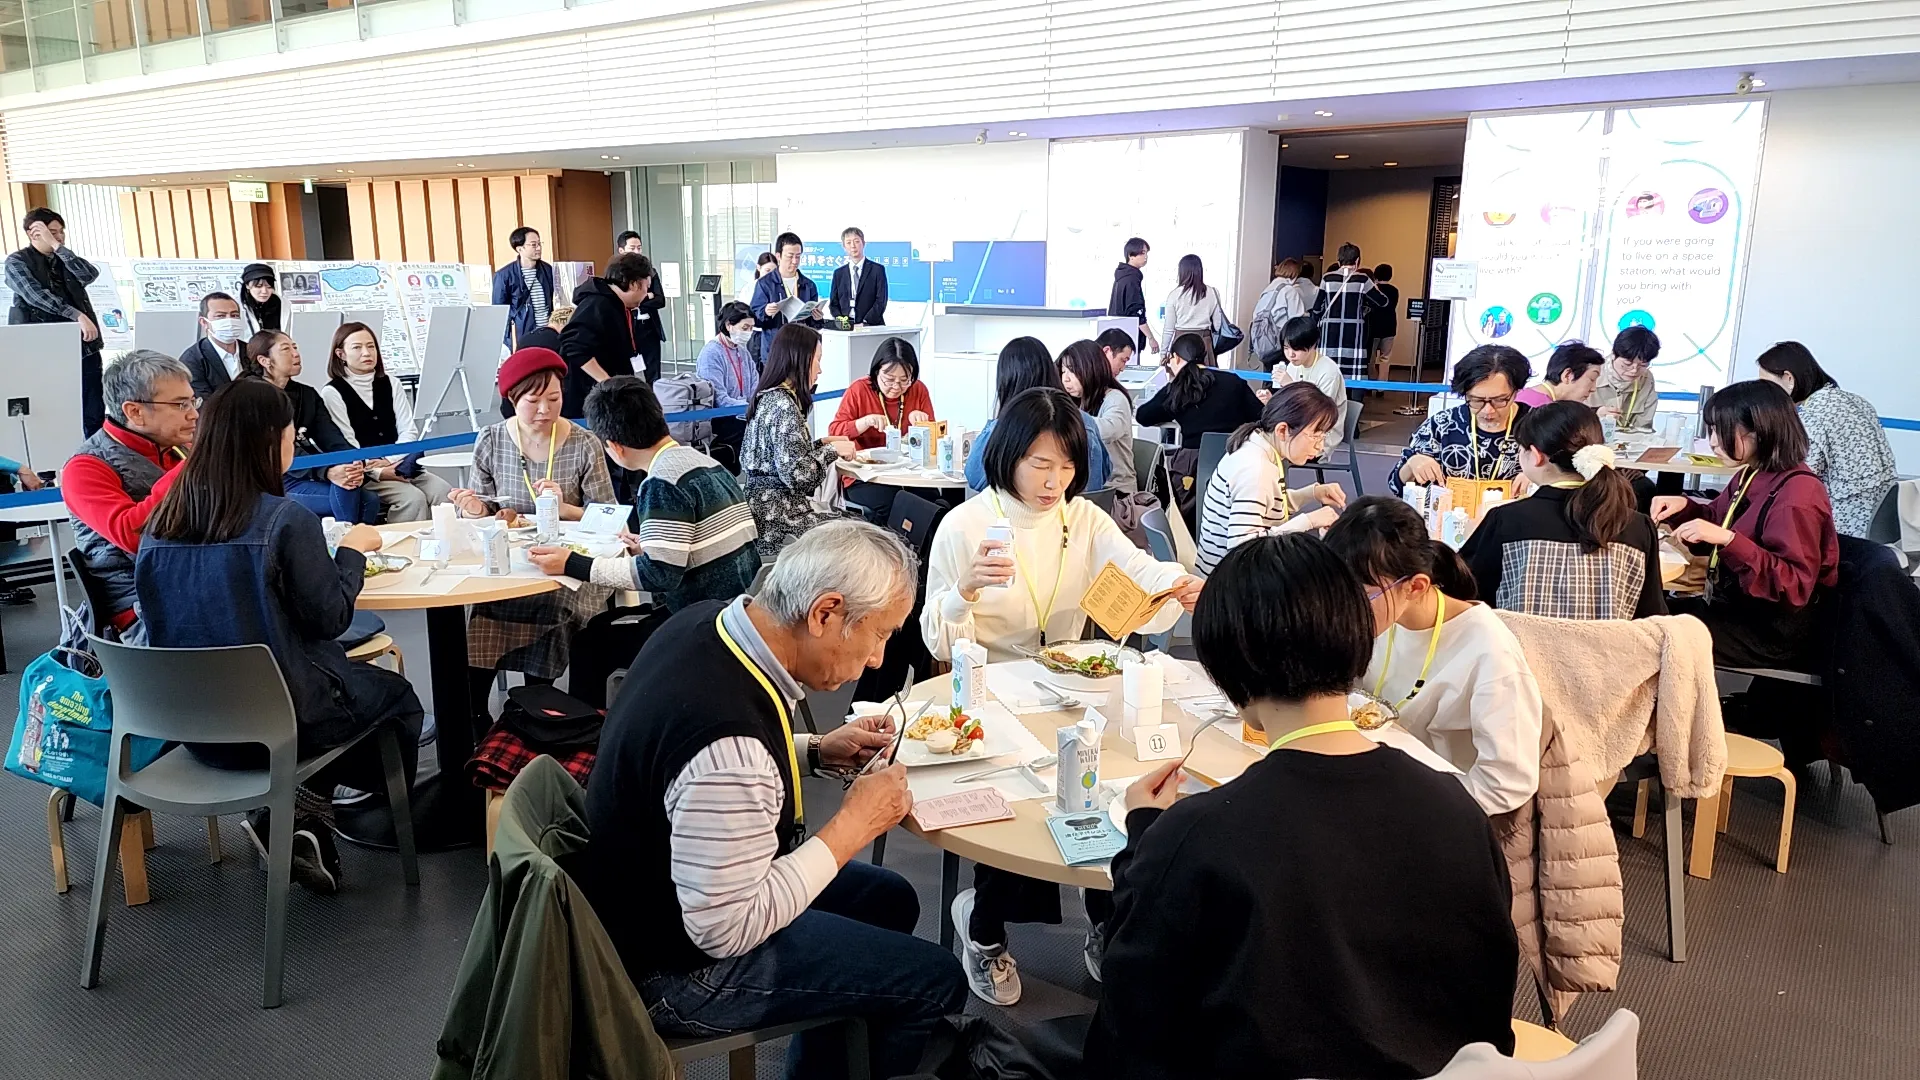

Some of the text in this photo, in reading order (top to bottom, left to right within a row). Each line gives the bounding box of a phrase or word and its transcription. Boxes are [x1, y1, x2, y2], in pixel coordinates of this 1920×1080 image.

[1623, 237, 1630, 245] If
[1633, 239, 1652, 248] you
[1684, 237, 1715, 248] going
[1622, 252, 1632, 260] to
[1635, 251, 1652, 260] live
[1682, 252, 1714, 262] space
[1660, 266, 1686, 275] what
[1689, 266, 1721, 275] would
[1618, 281, 1692, 292] you bring with
[1616, 295, 1642, 305] you?
[71, 690, 85, 702] The
[59, 695, 90, 716] amazing
[1080, 754, 1098, 764] WATER
